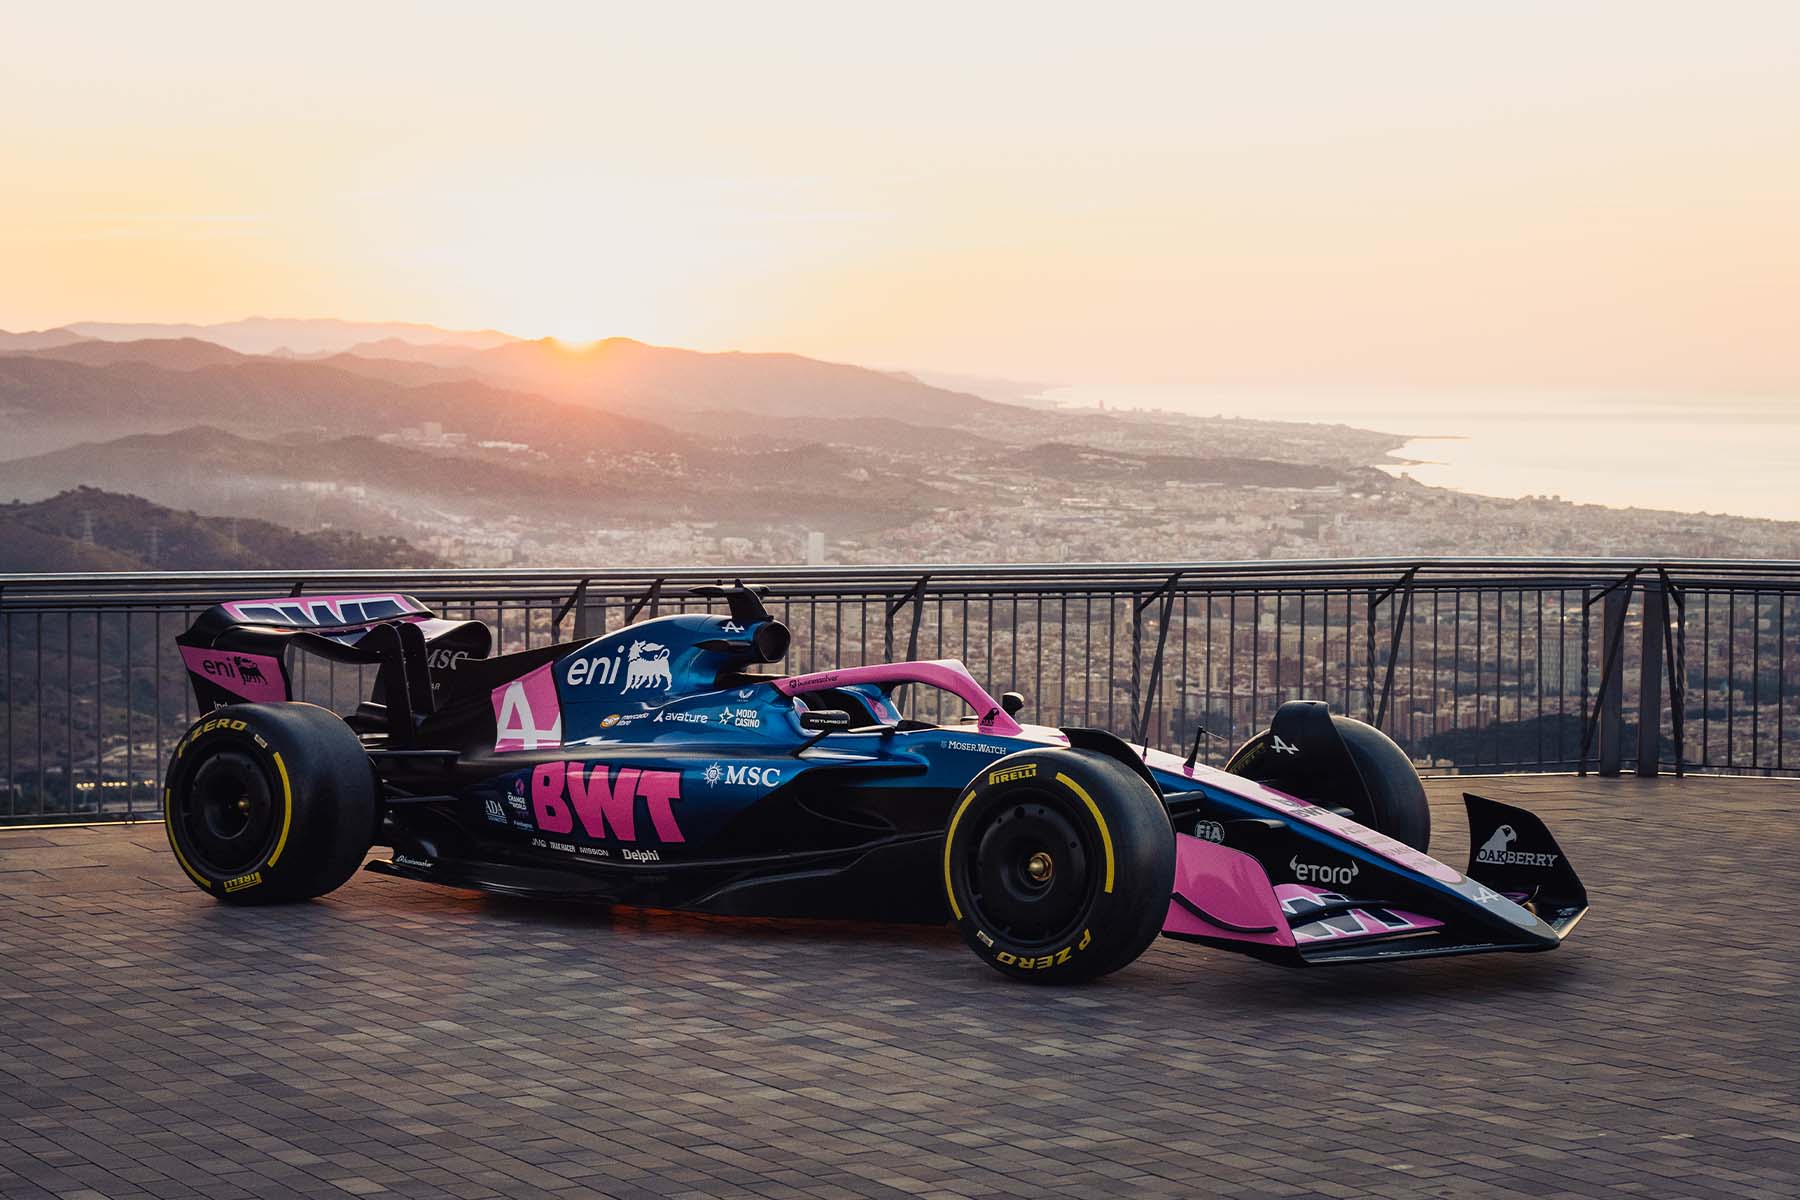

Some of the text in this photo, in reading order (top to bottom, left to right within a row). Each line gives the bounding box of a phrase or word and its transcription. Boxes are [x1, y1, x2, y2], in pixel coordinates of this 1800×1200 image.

[203, 656, 235, 678] eni
[567, 644, 625, 686] eni
[665, 711, 708, 724] avature
[734, 717, 760, 728] CASINO
[736, 708, 757, 719] MODO
[191, 718, 247, 742] ZERO
[724, 765, 781, 788] MSC
[988, 763, 1037, 785] PIRELLI
[531, 761, 686, 843] BWT
[621, 848, 660, 863] Delphi
[1478, 848, 1559, 867] OAKBERRY
[224, 872, 263, 893] PIRELLI
[996, 928, 1092, 969] P ZERO
